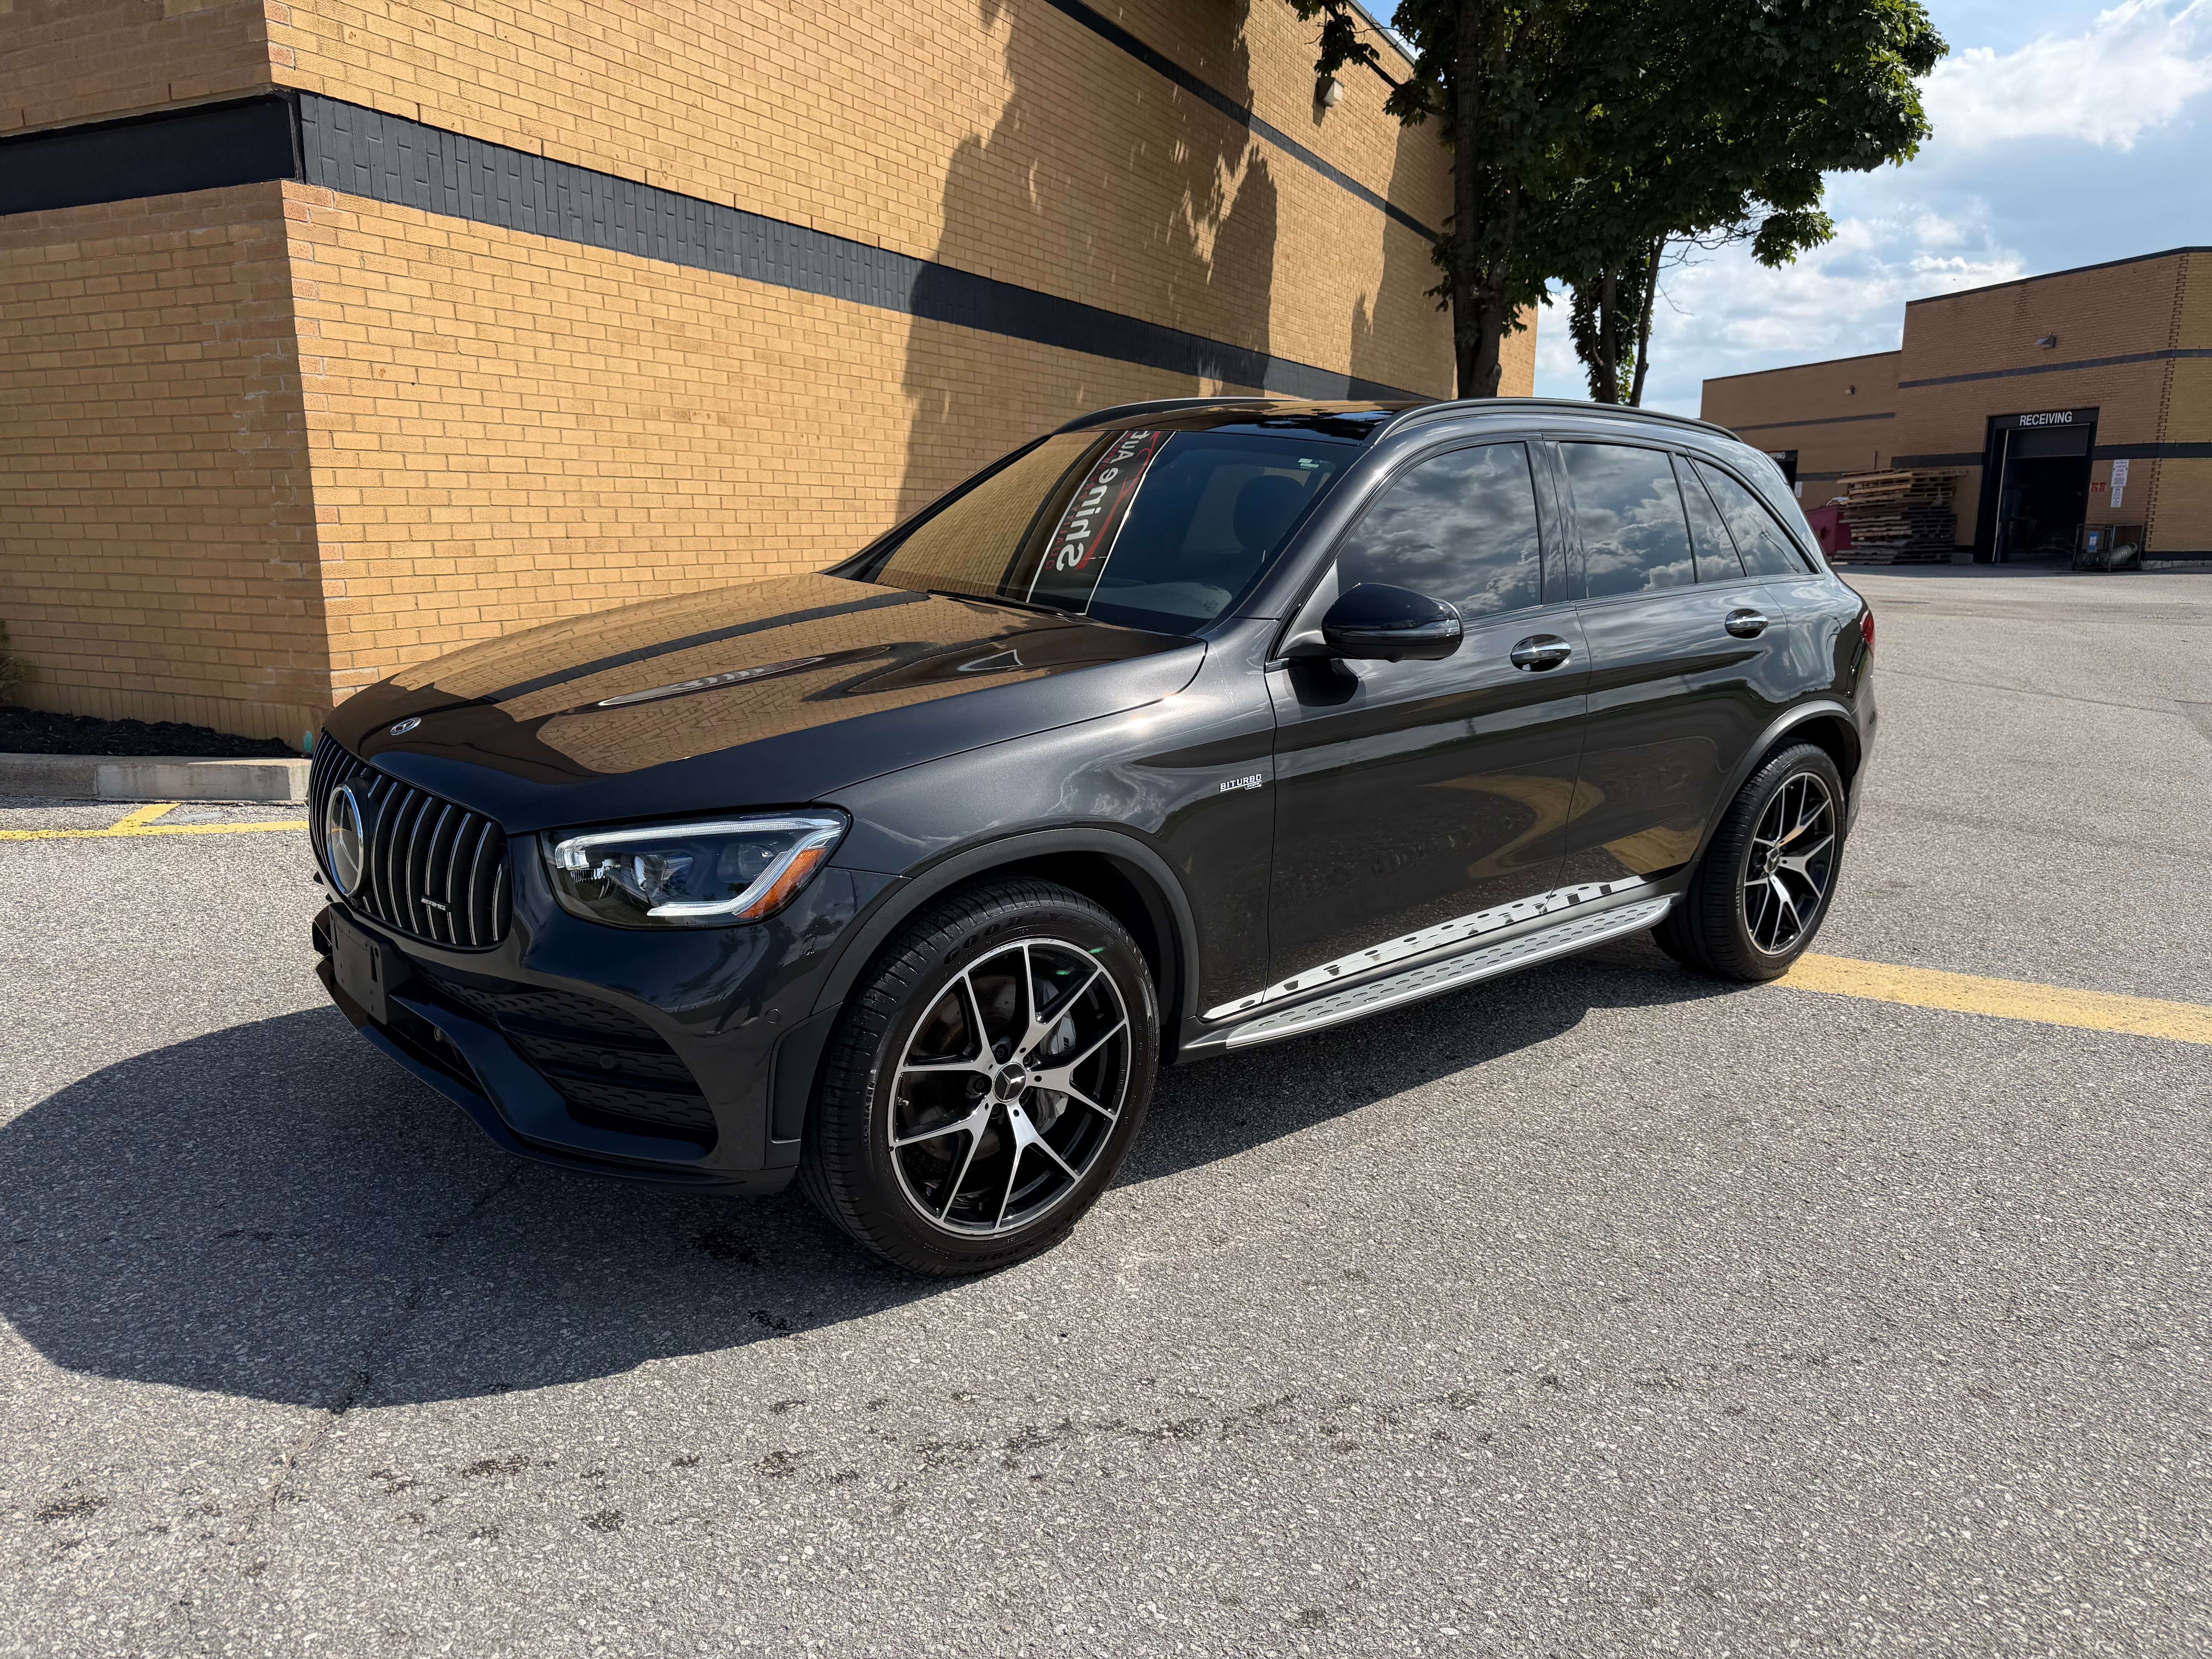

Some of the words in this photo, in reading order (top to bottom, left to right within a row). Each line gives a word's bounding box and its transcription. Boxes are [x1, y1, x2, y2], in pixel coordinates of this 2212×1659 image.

[2019, 411, 2072, 426] RECEIVING
[1220, 774, 1261, 790] BITURBO
[428, 901, 446, 911] AMG
